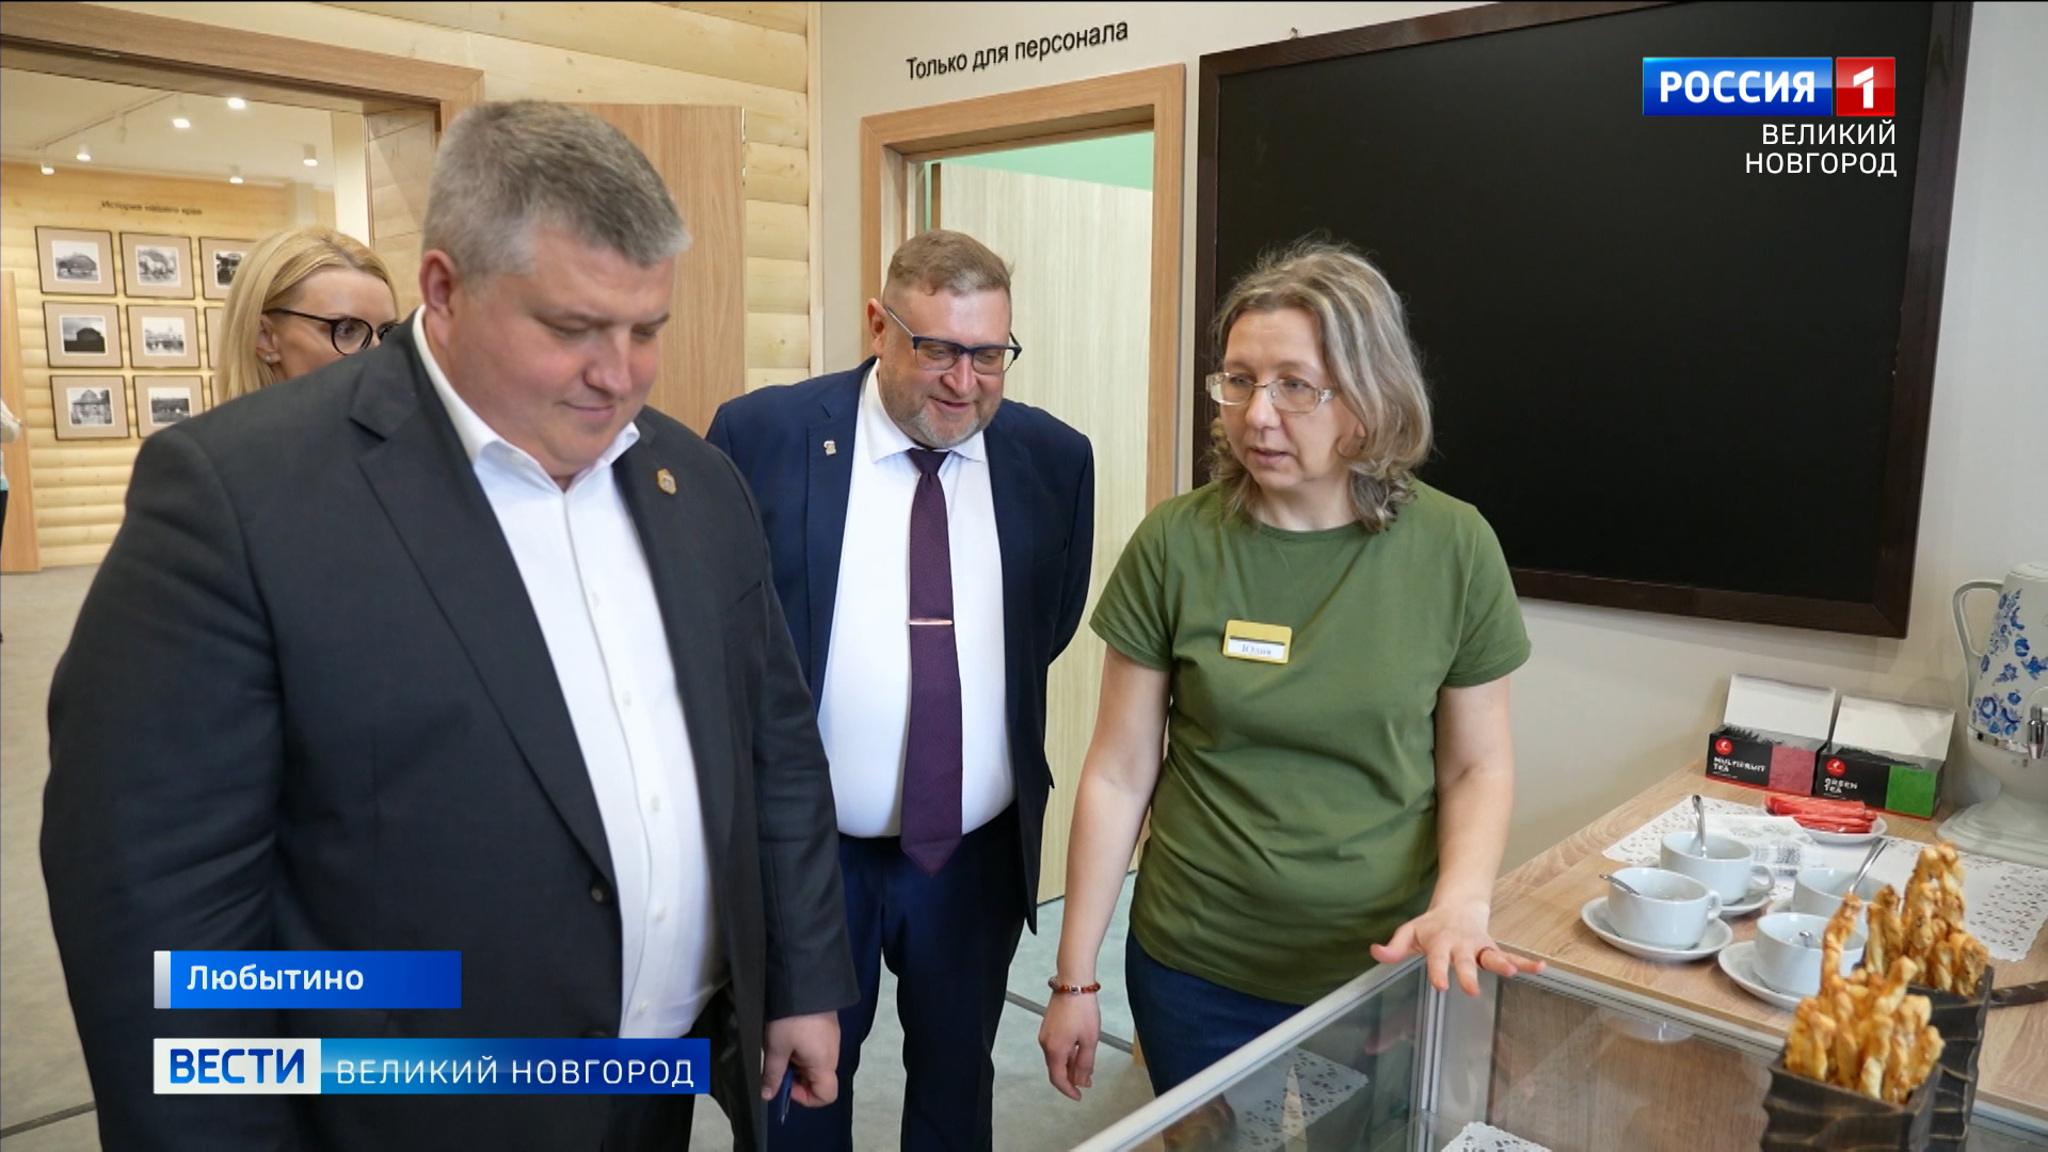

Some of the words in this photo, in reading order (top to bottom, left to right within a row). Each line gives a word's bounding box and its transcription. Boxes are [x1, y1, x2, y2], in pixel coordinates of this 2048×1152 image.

[906, 53, 967, 80] Только
[972, 45, 1008, 72] для
[1015, 21, 1129, 61] персонала
[1713, 763, 1730, 773] TEA
[1824, 777, 1858, 790] GREEN
[1824, 785, 1842, 794] TEA
